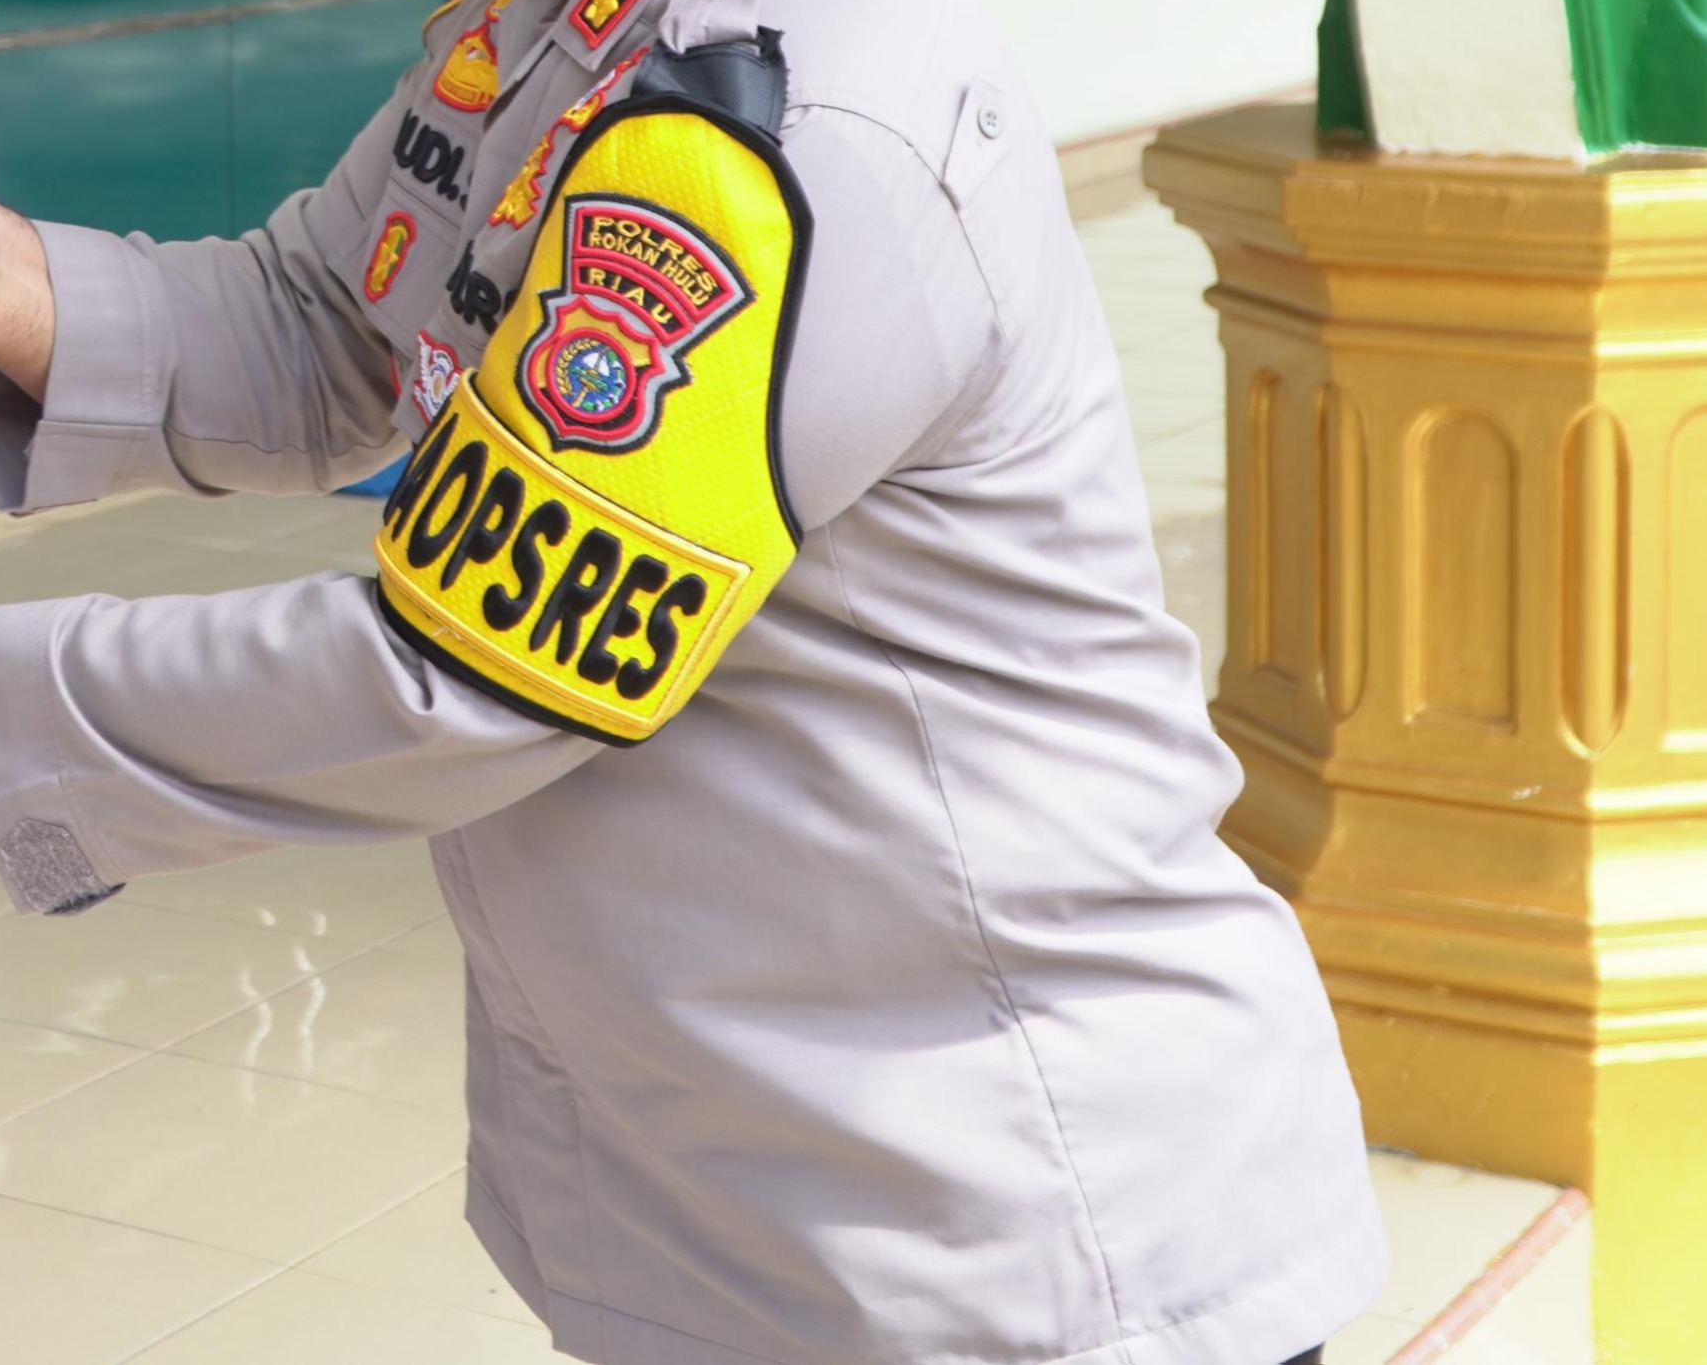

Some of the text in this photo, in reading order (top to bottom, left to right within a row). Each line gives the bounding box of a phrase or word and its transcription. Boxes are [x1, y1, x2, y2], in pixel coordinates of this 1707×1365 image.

[589, 230, 710, 306] ROKAN HULU
[593, 216, 718, 294] POLRES
[588, 267, 673, 324] RIAU
